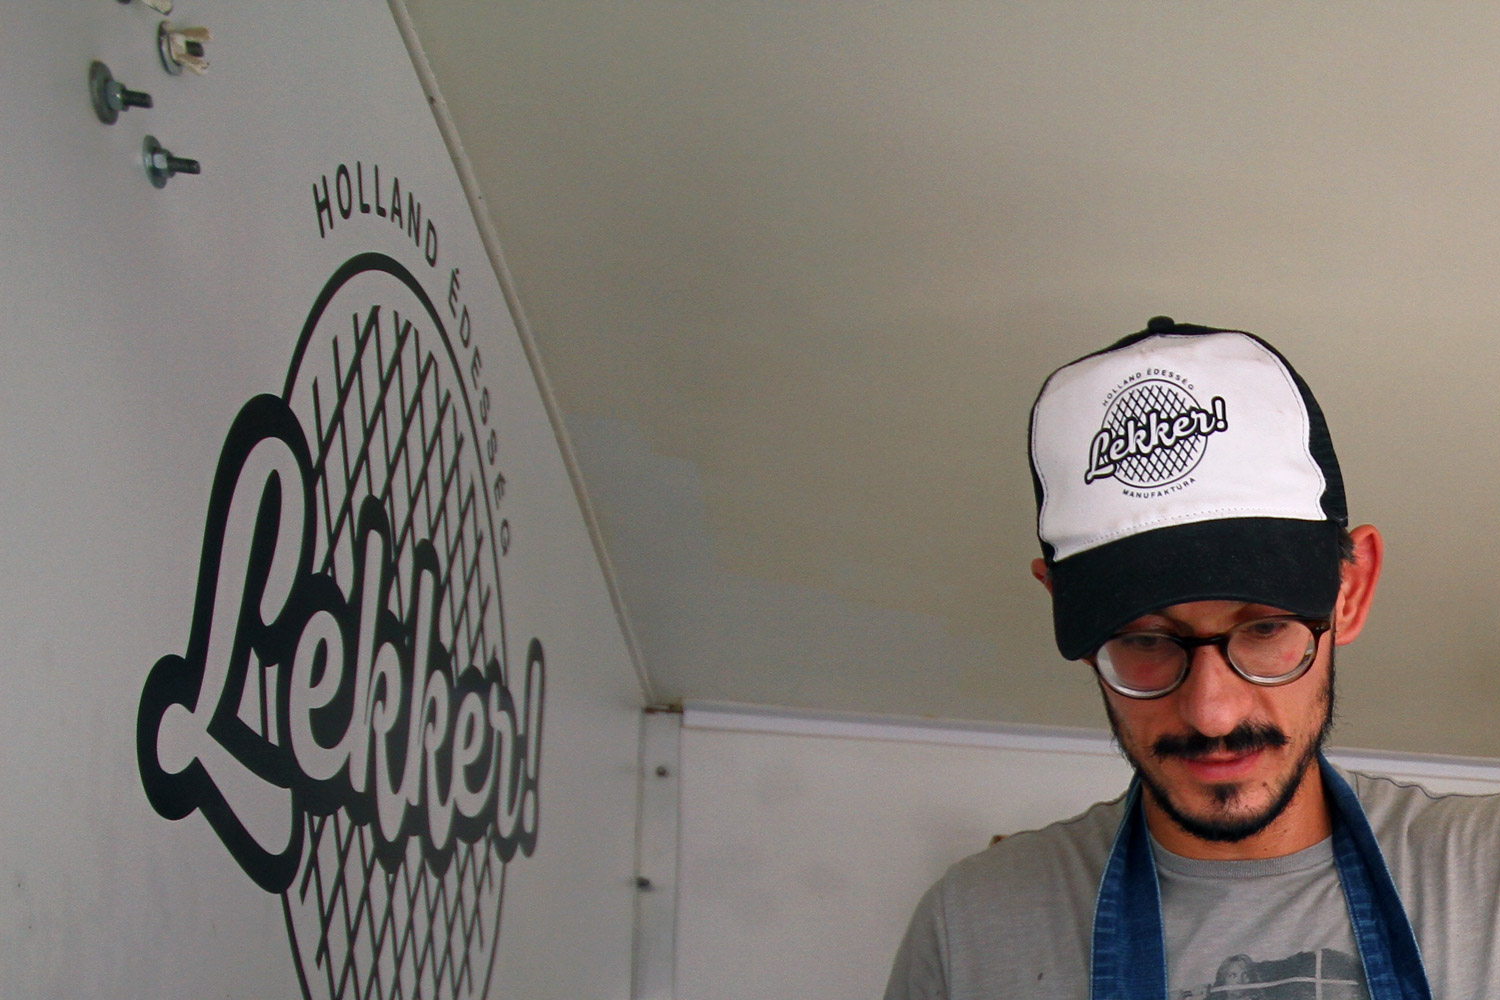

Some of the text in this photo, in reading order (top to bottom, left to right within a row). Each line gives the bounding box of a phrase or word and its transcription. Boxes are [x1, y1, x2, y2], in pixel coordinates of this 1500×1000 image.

[312, 160, 511, 557] HOLLAND ÉDESSÉG
[1102, 368, 1195, 407] HOLLAND ÉDESSÉG
[1084, 396, 1229, 485] Lekker!
[1122, 476, 1196, 499] MANUFAKTÚRA
[137, 393, 546, 894] Lekker!
